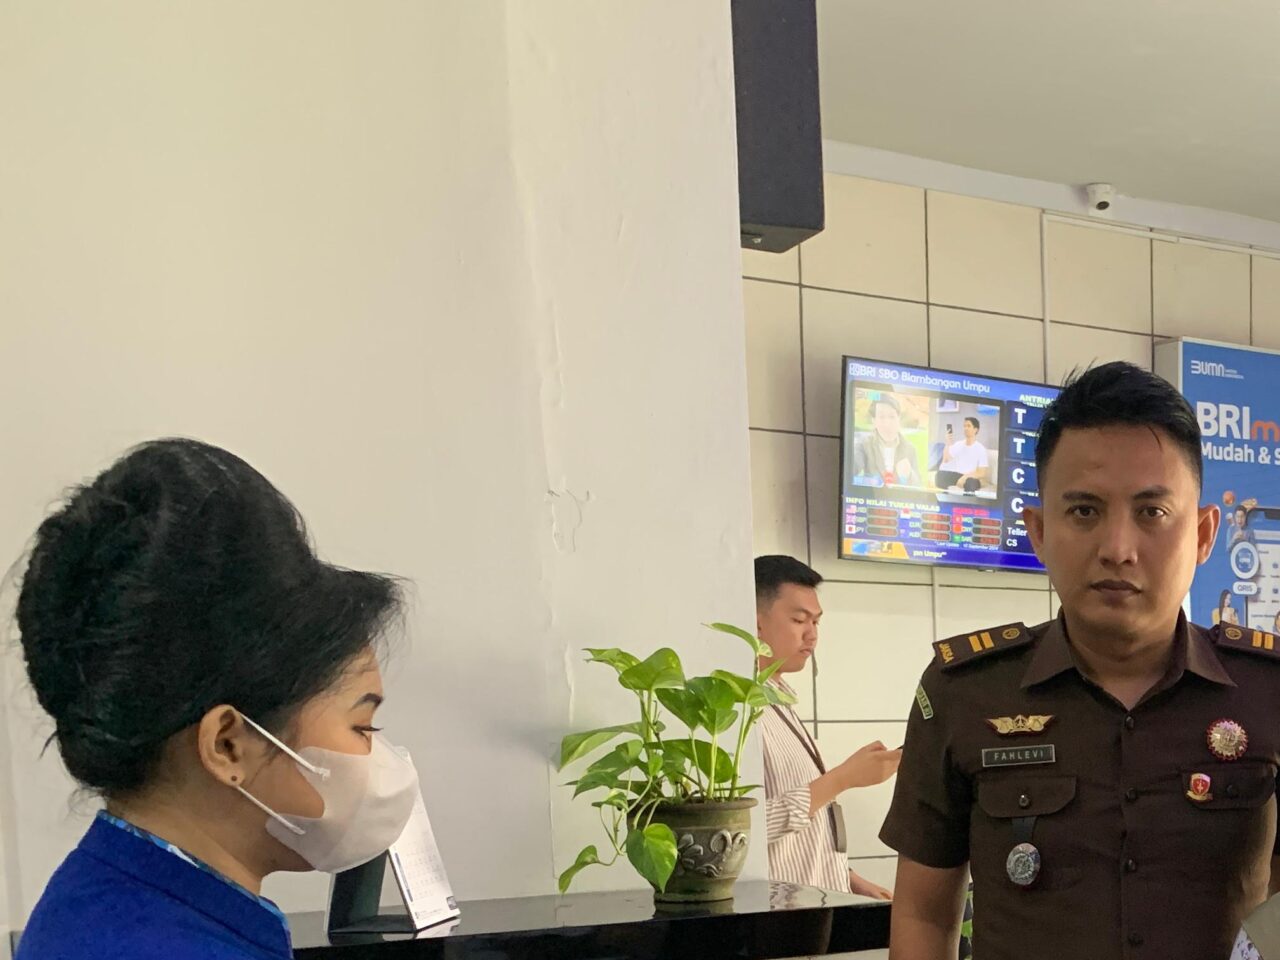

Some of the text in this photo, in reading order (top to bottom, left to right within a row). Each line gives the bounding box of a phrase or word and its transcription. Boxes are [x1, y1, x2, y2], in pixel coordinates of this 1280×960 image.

[860, 365, 991, 393] BRI SBO Blambangan Umpu
[1014, 408, 1026, 424] T
[1013, 438, 1025, 454] T
[1201, 442, 1254, 464] Mudah
[1258, 447, 1271, 465] &
[1012, 468, 1025, 484] C
[1011, 497, 1024, 513] C
[1007, 527, 1028, 536] Teller
[1006, 538, 1018, 547] CS
[993, 749, 1044, 761] FAHLEVI
